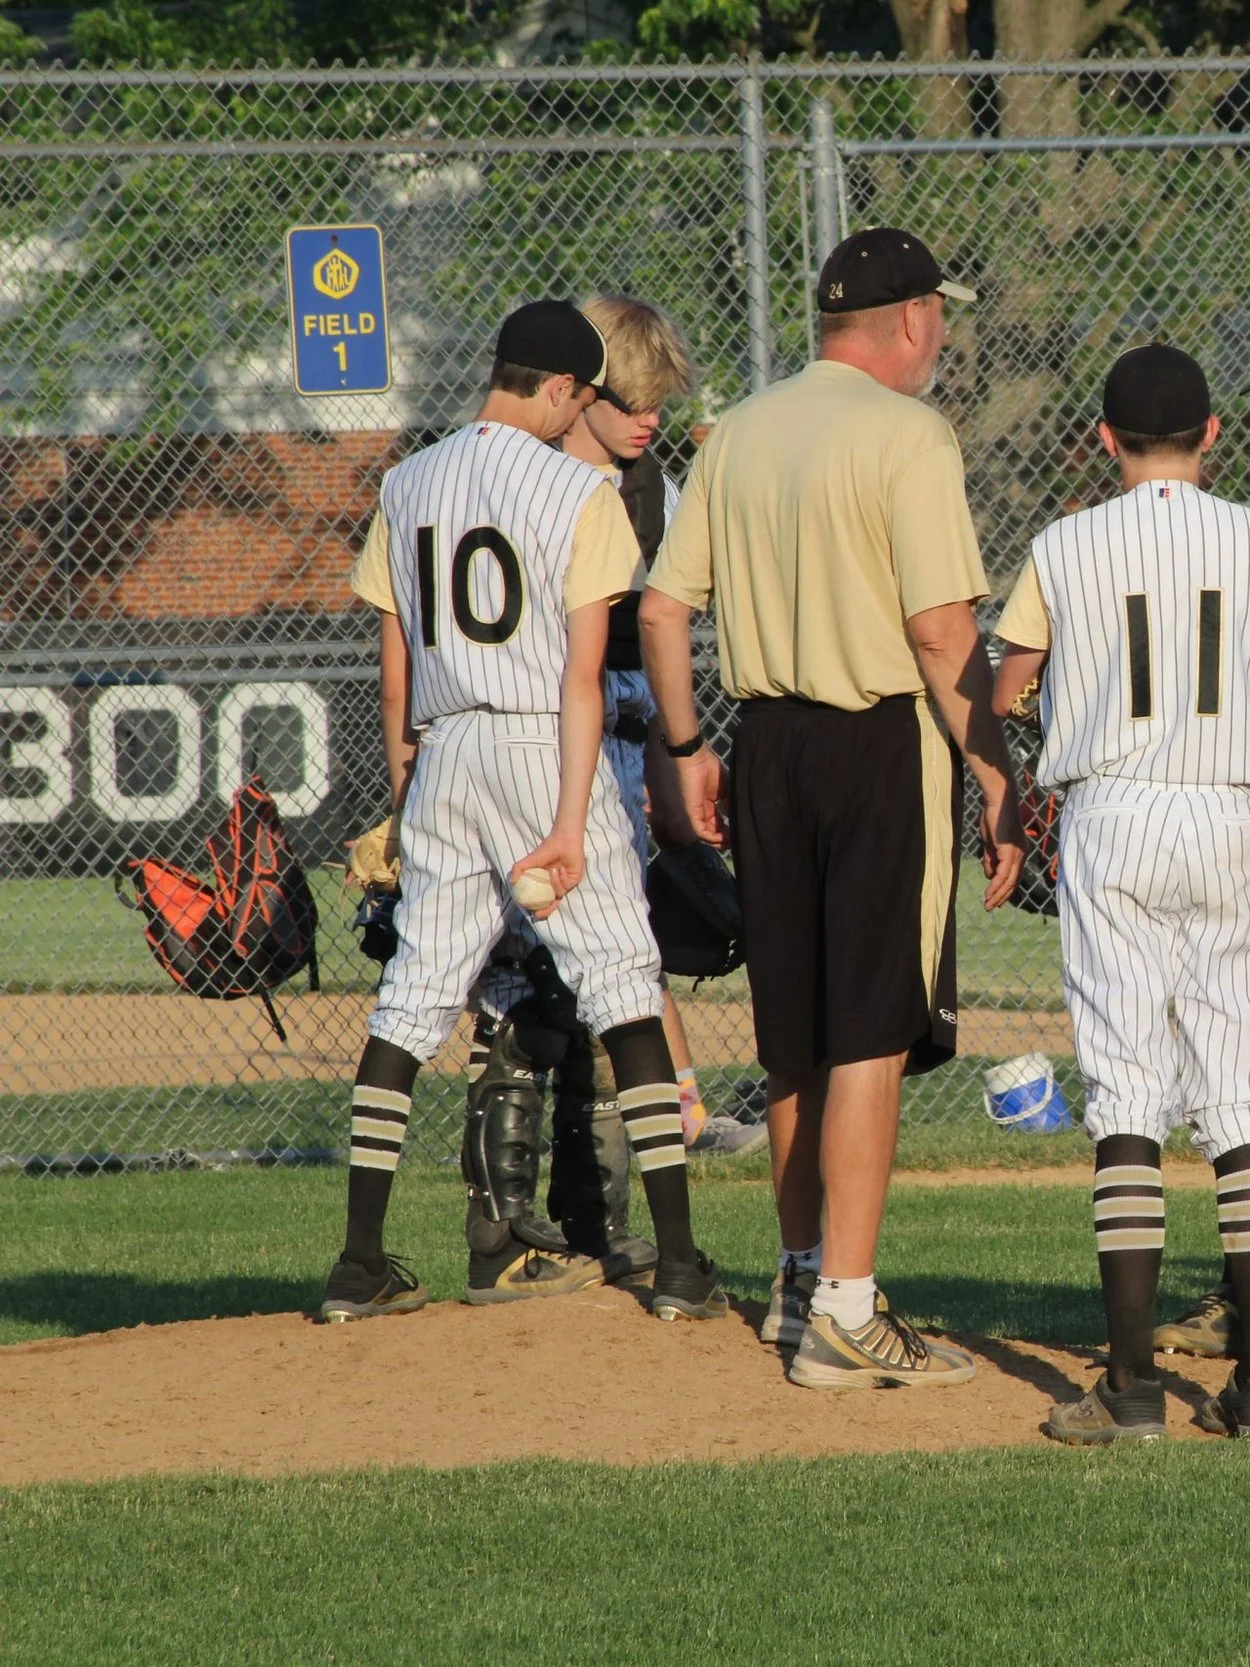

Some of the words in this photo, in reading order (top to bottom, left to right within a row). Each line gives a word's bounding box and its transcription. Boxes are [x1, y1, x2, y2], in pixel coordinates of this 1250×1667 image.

[303, 312, 376, 336] FIELD
[829, 282, 845, 300] 24
[332, 341, 348, 371] 1
[416, 523, 526, 650] 10
[1123, 587, 1226, 722] 11
[0, 682, 330, 823] 300
